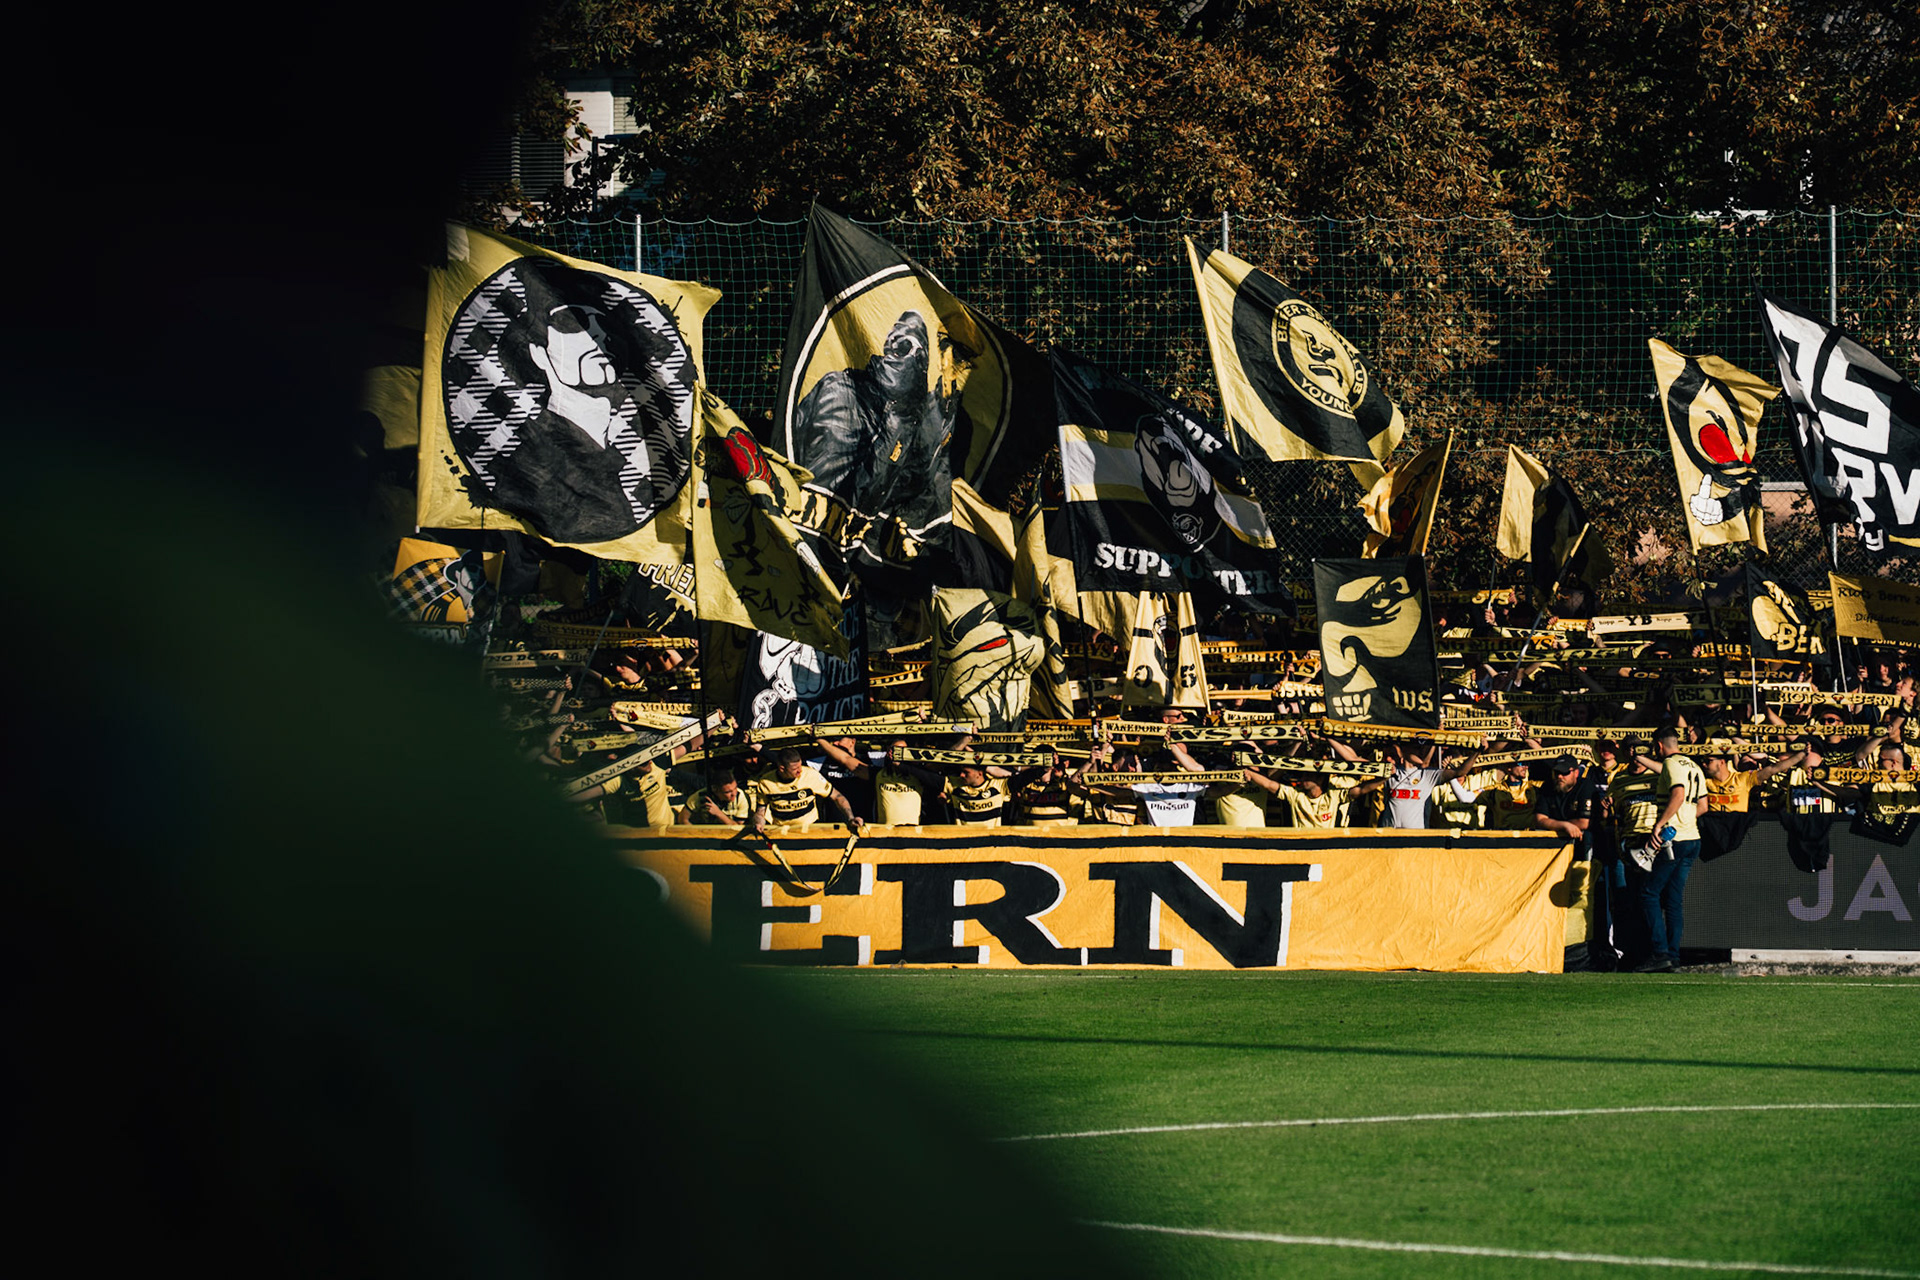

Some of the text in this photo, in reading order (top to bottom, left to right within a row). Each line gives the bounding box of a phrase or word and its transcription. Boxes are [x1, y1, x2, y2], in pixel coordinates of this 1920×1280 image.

[1625, 615, 1652, 627] YB
[1748, 723, 1866, 736] RIOTS BERN
[1433, 733, 1482, 749] BERN
[1837, 769, 1884, 783] RIOTS
[1787, 853, 1920, 922] JA
[632, 860, 1322, 968] ERN
